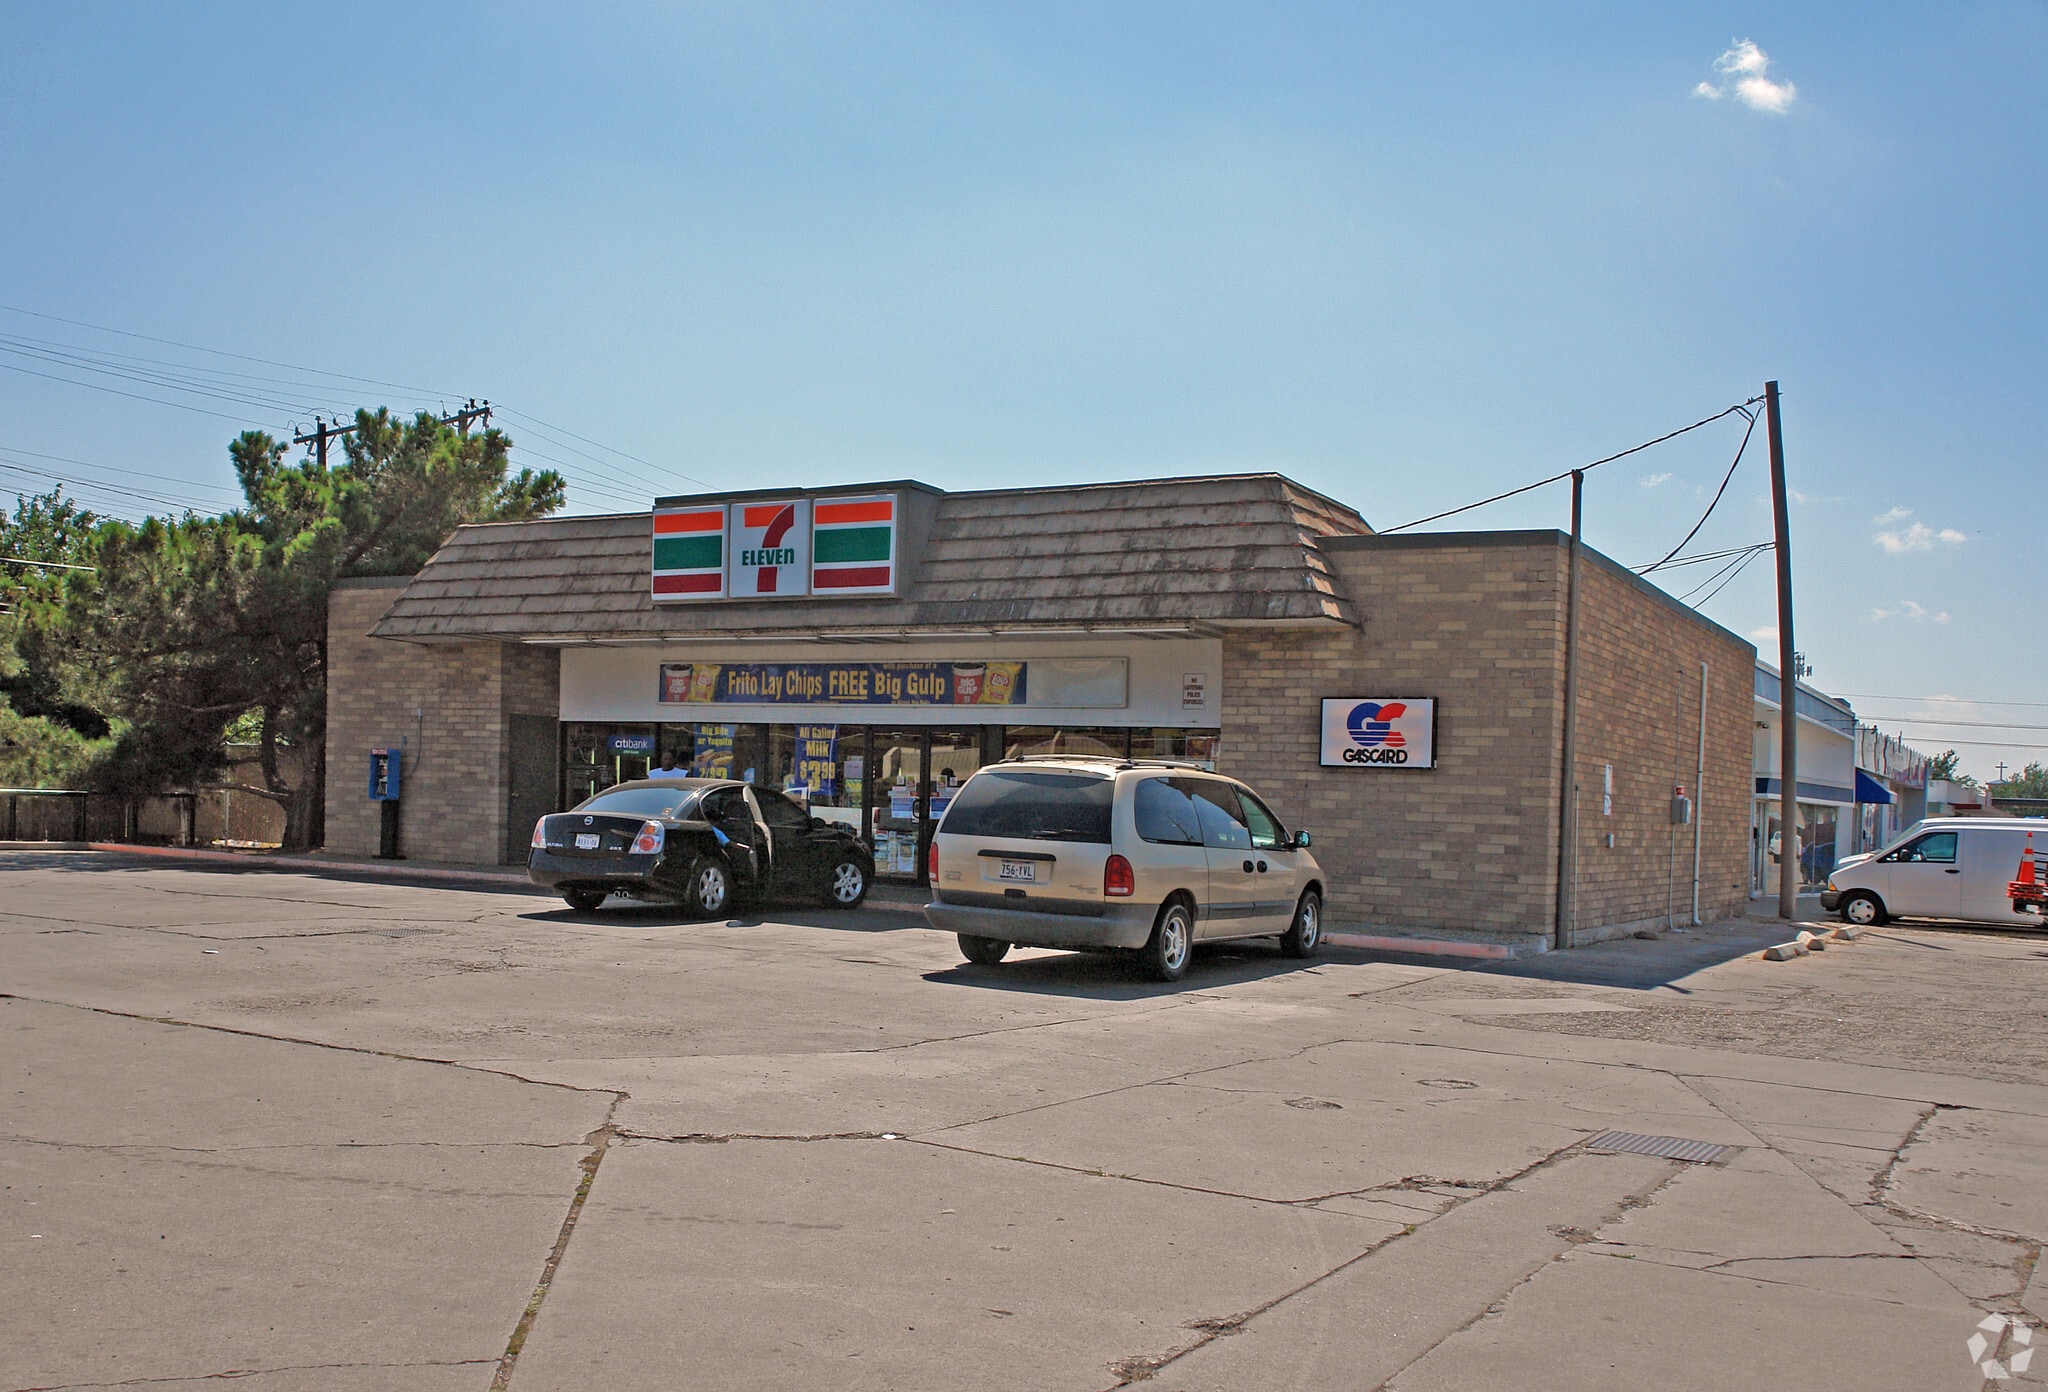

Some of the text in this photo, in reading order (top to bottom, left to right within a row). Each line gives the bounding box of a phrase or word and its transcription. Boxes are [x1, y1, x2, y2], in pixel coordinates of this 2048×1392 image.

[728, 670, 946, 700] Frito Lay Chips FREE Big Gulp
[960, 678, 976, 687] BIG
[957, 686, 978, 695] GULP
[800, 727, 836, 739] All Gallon
[615, 739, 648, 749] citibank
[806, 741, 829, 757] Milk
[1343, 748, 1408, 764] GASCARD
